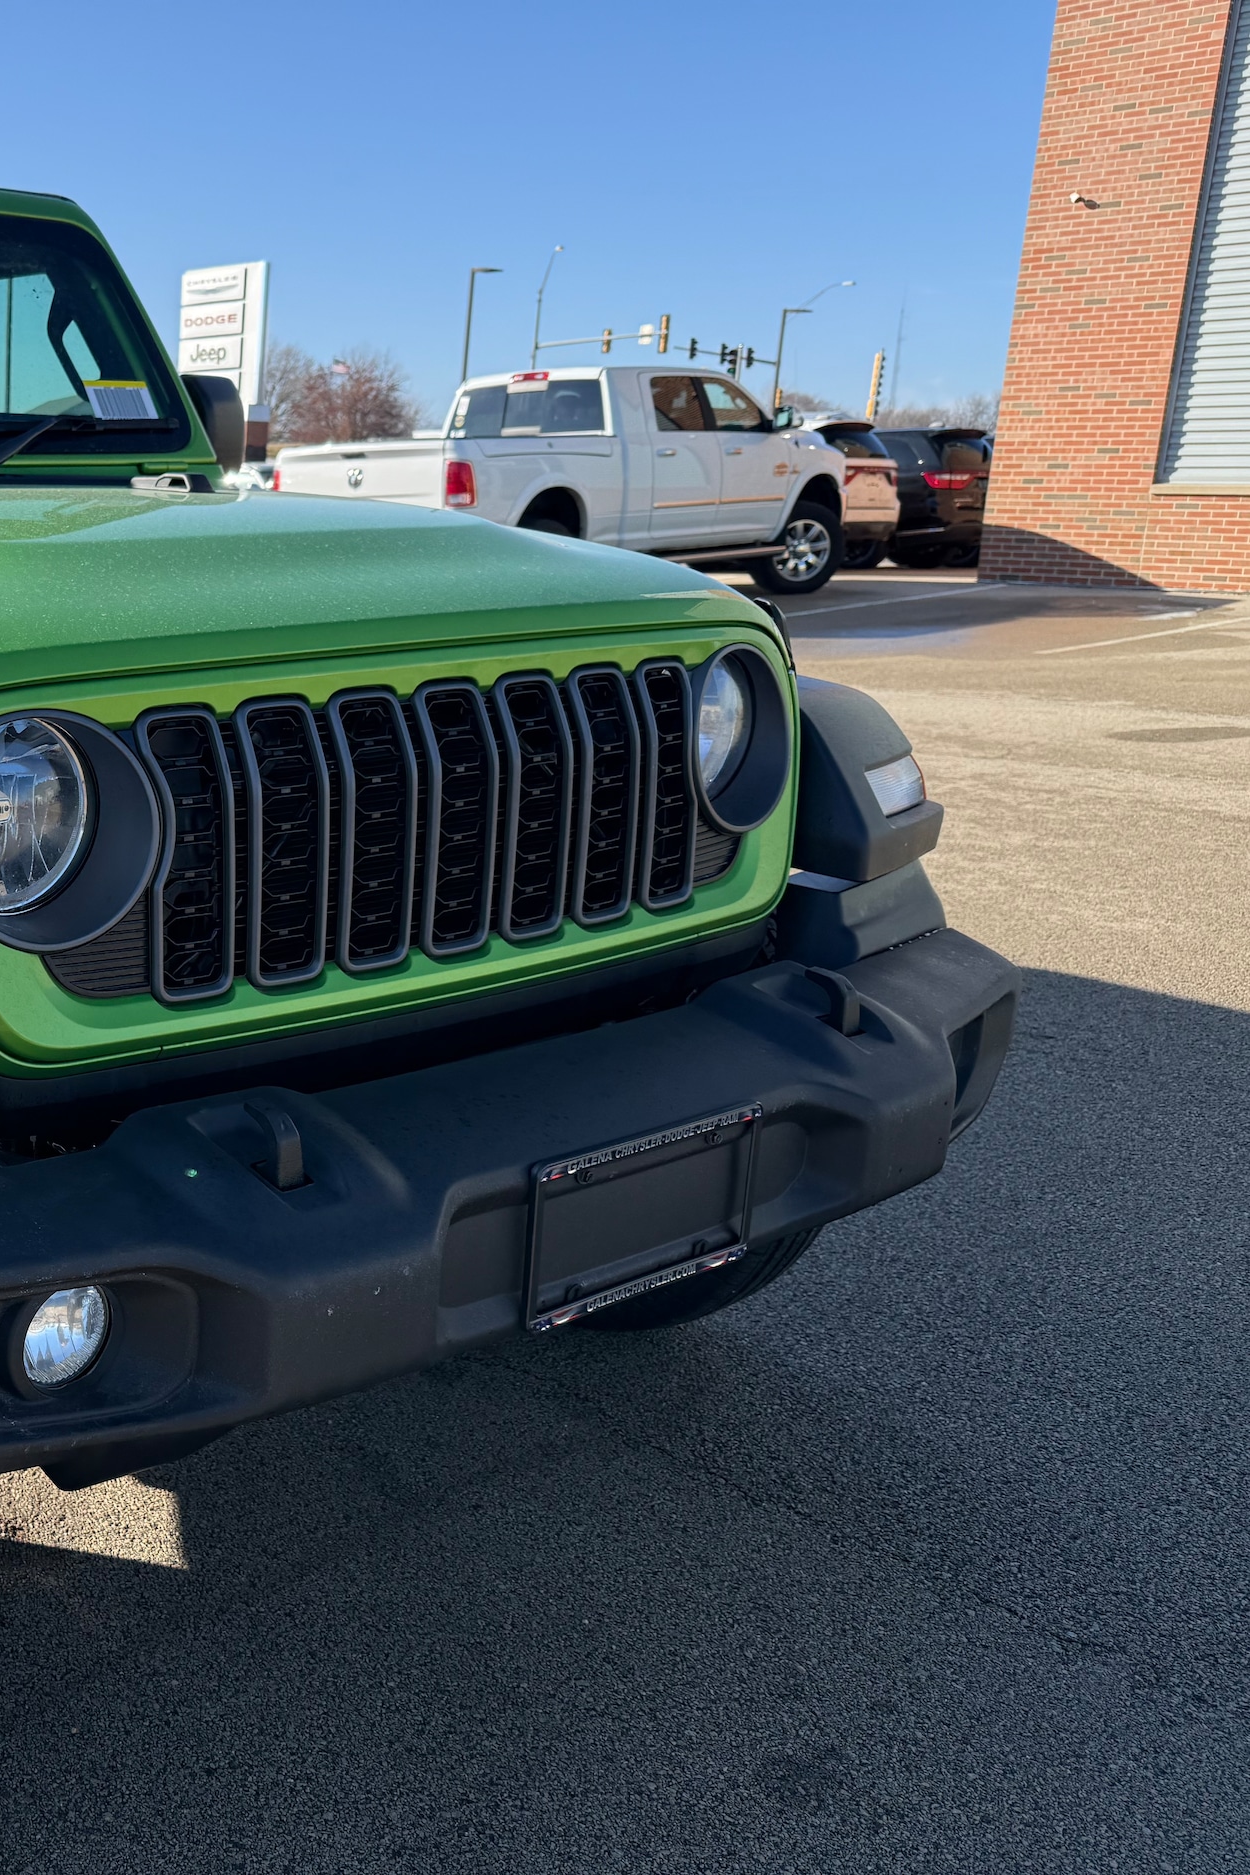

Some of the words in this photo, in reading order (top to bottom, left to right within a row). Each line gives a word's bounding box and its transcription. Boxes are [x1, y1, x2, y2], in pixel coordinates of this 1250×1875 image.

[184, 313, 238, 328] DODGE
[190, 344, 227, 365] Jeep
[567, 1153, 613, 1174] GALENA
[586, 1263, 697, 1312] GALENACHRYSLER.COM
